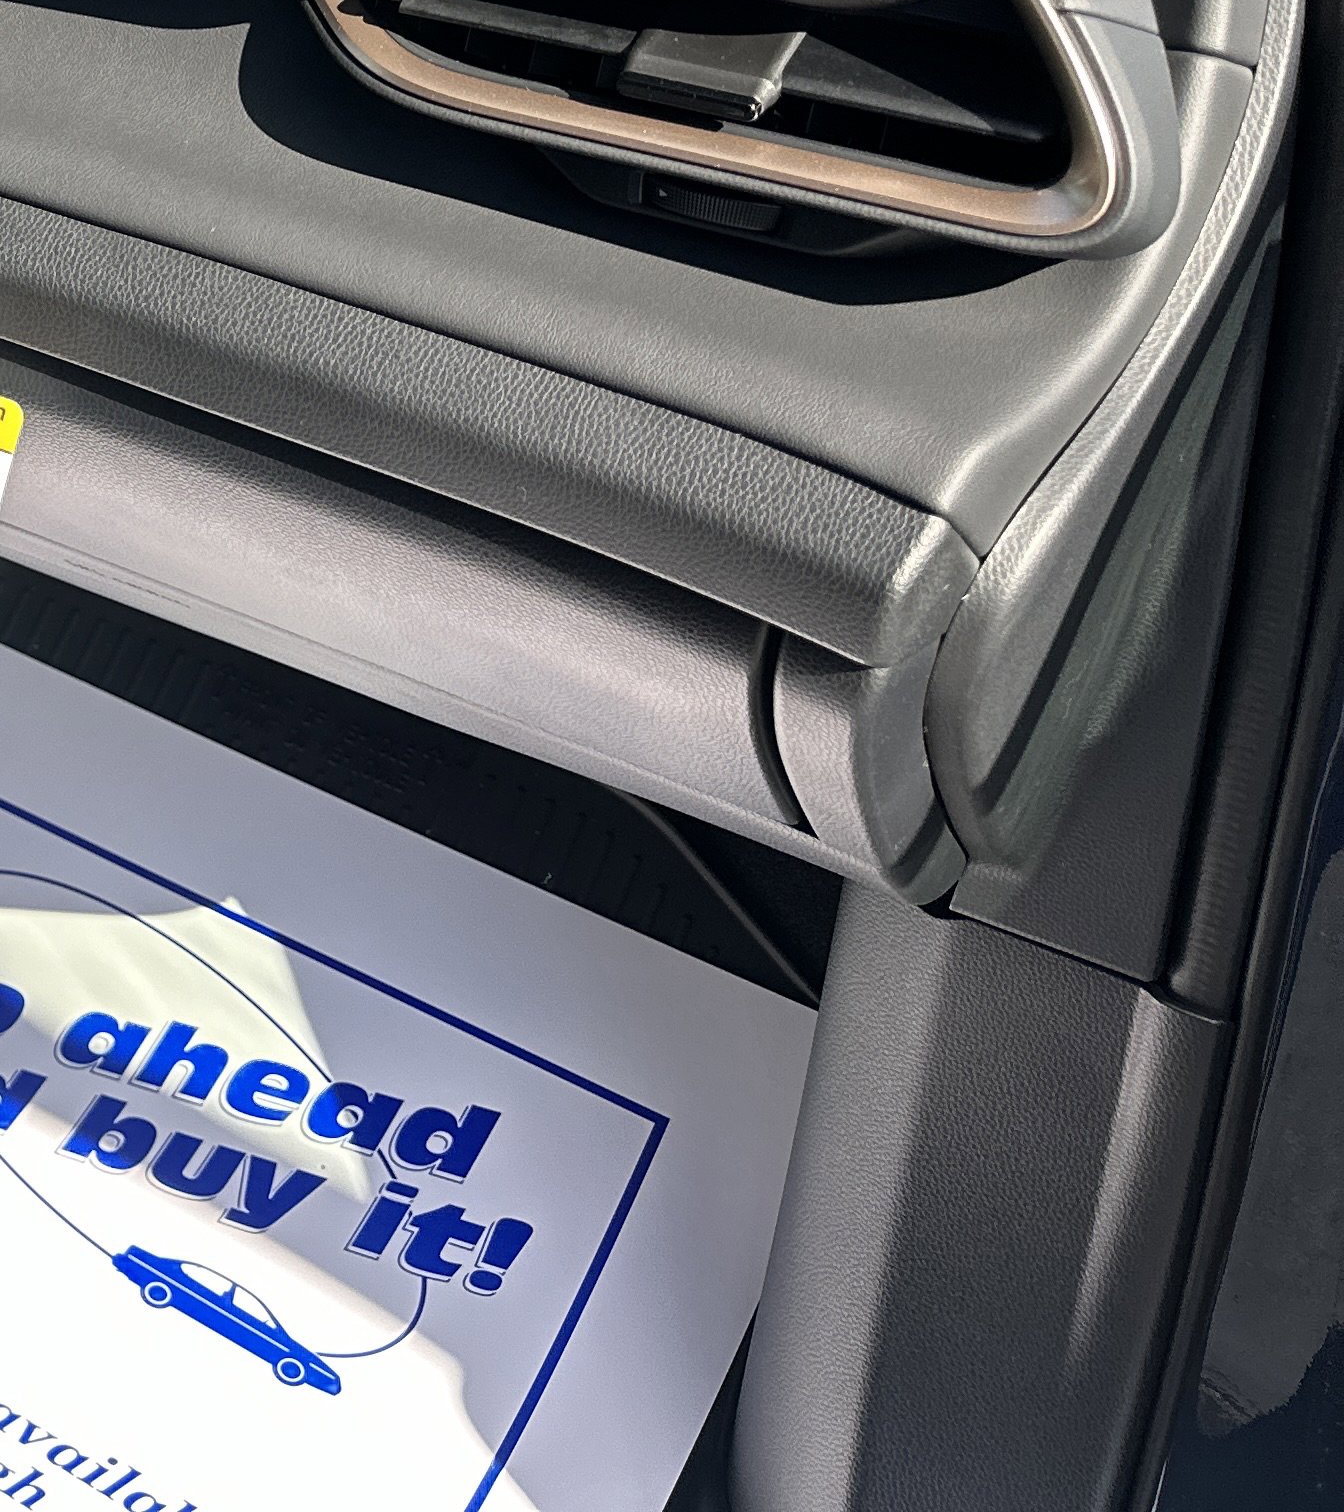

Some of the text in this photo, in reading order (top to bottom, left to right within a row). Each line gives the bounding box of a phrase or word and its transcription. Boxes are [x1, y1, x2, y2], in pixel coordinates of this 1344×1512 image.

[53, 1010, 502, 1184] ahead
[55, 1093, 327, 1234] buy
[344, 1177, 534, 1297] it!
